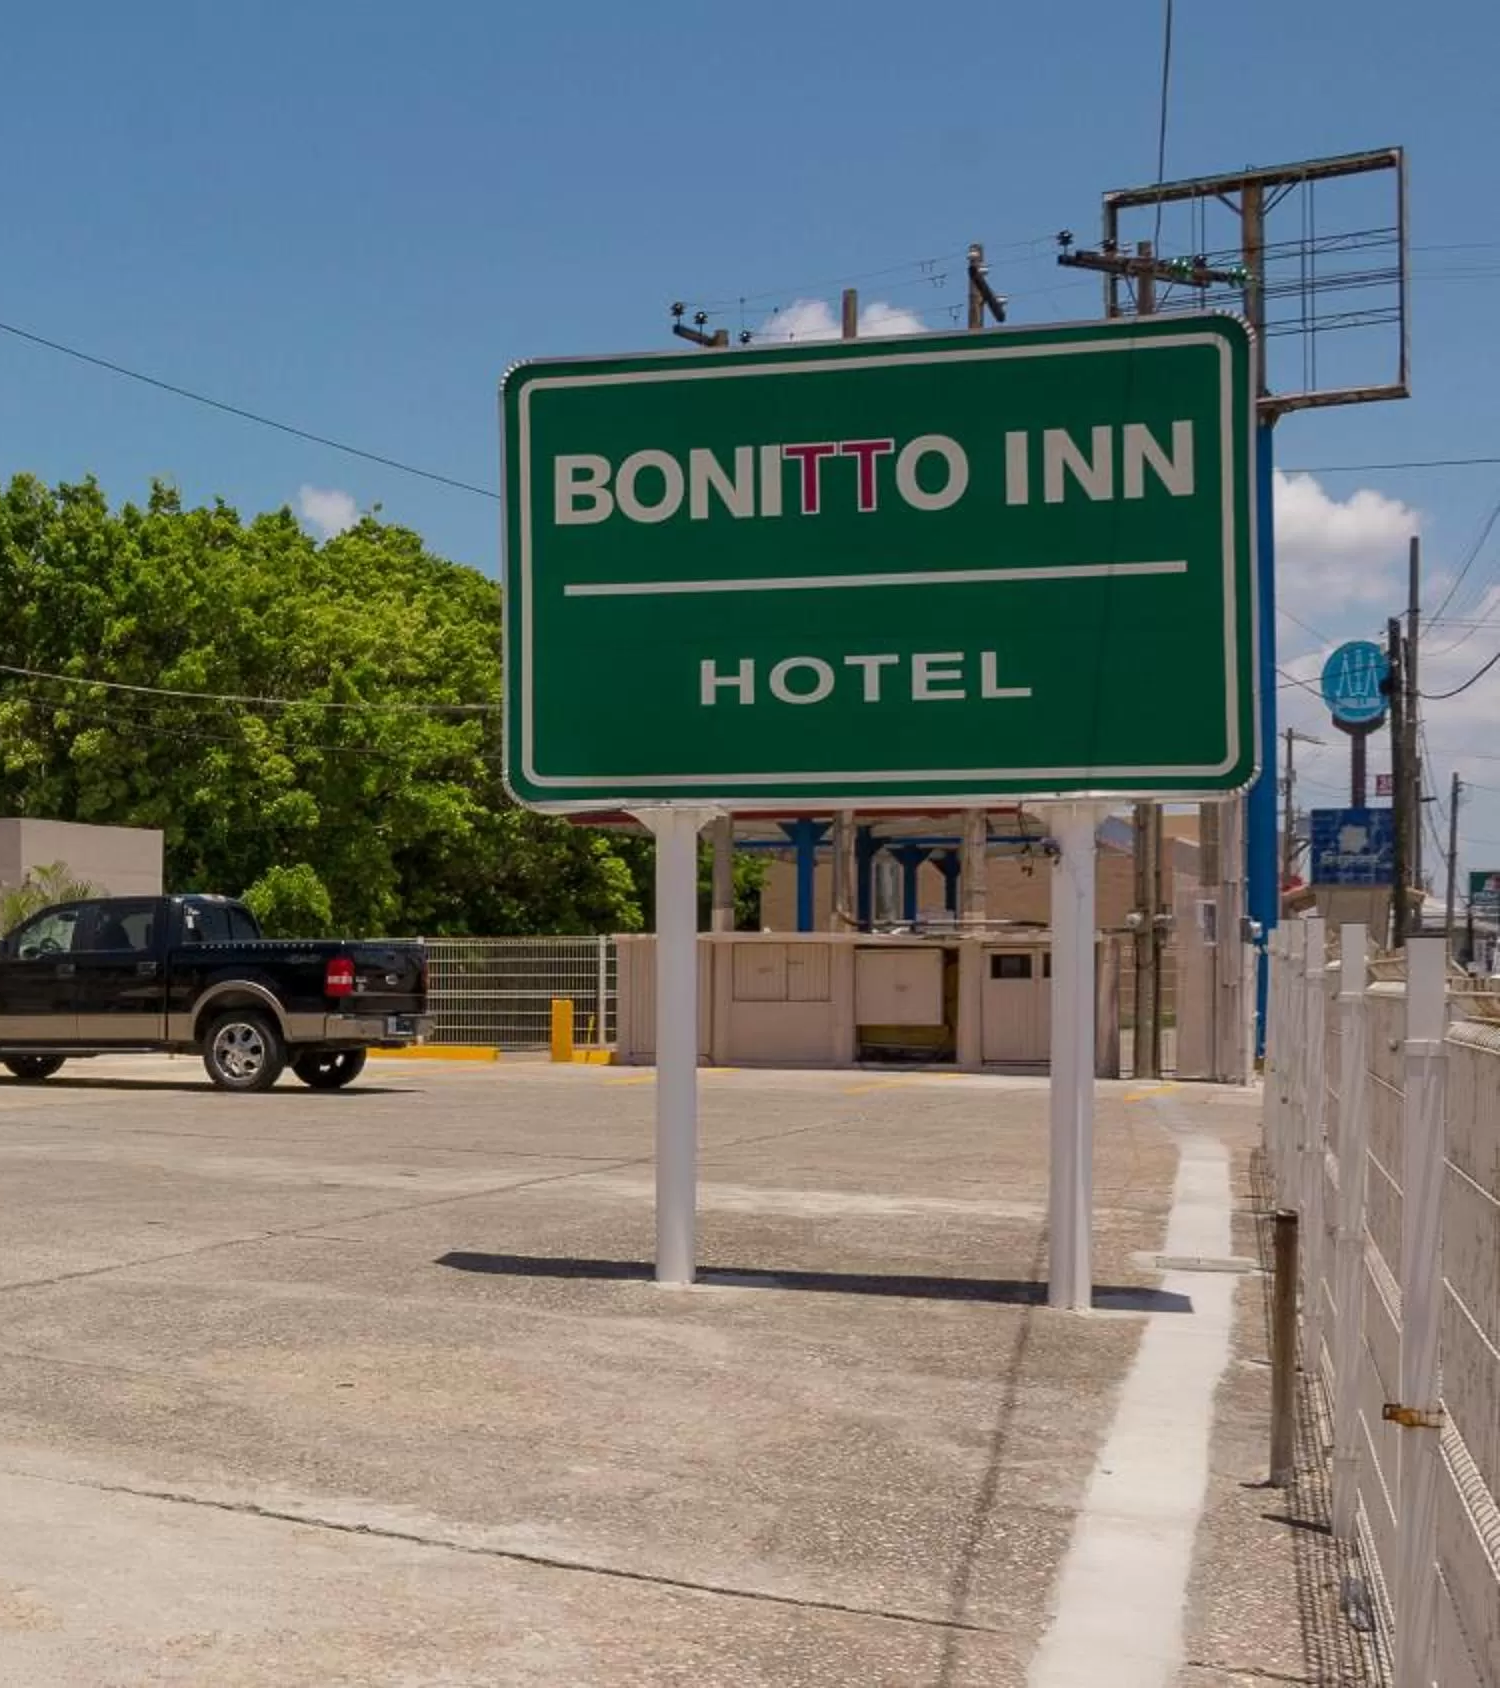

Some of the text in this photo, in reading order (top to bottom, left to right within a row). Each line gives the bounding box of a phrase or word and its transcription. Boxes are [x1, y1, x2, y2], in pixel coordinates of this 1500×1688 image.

[554, 420, 1194, 525] BONITTO INN
[700, 651, 1032, 705] HOTEL
